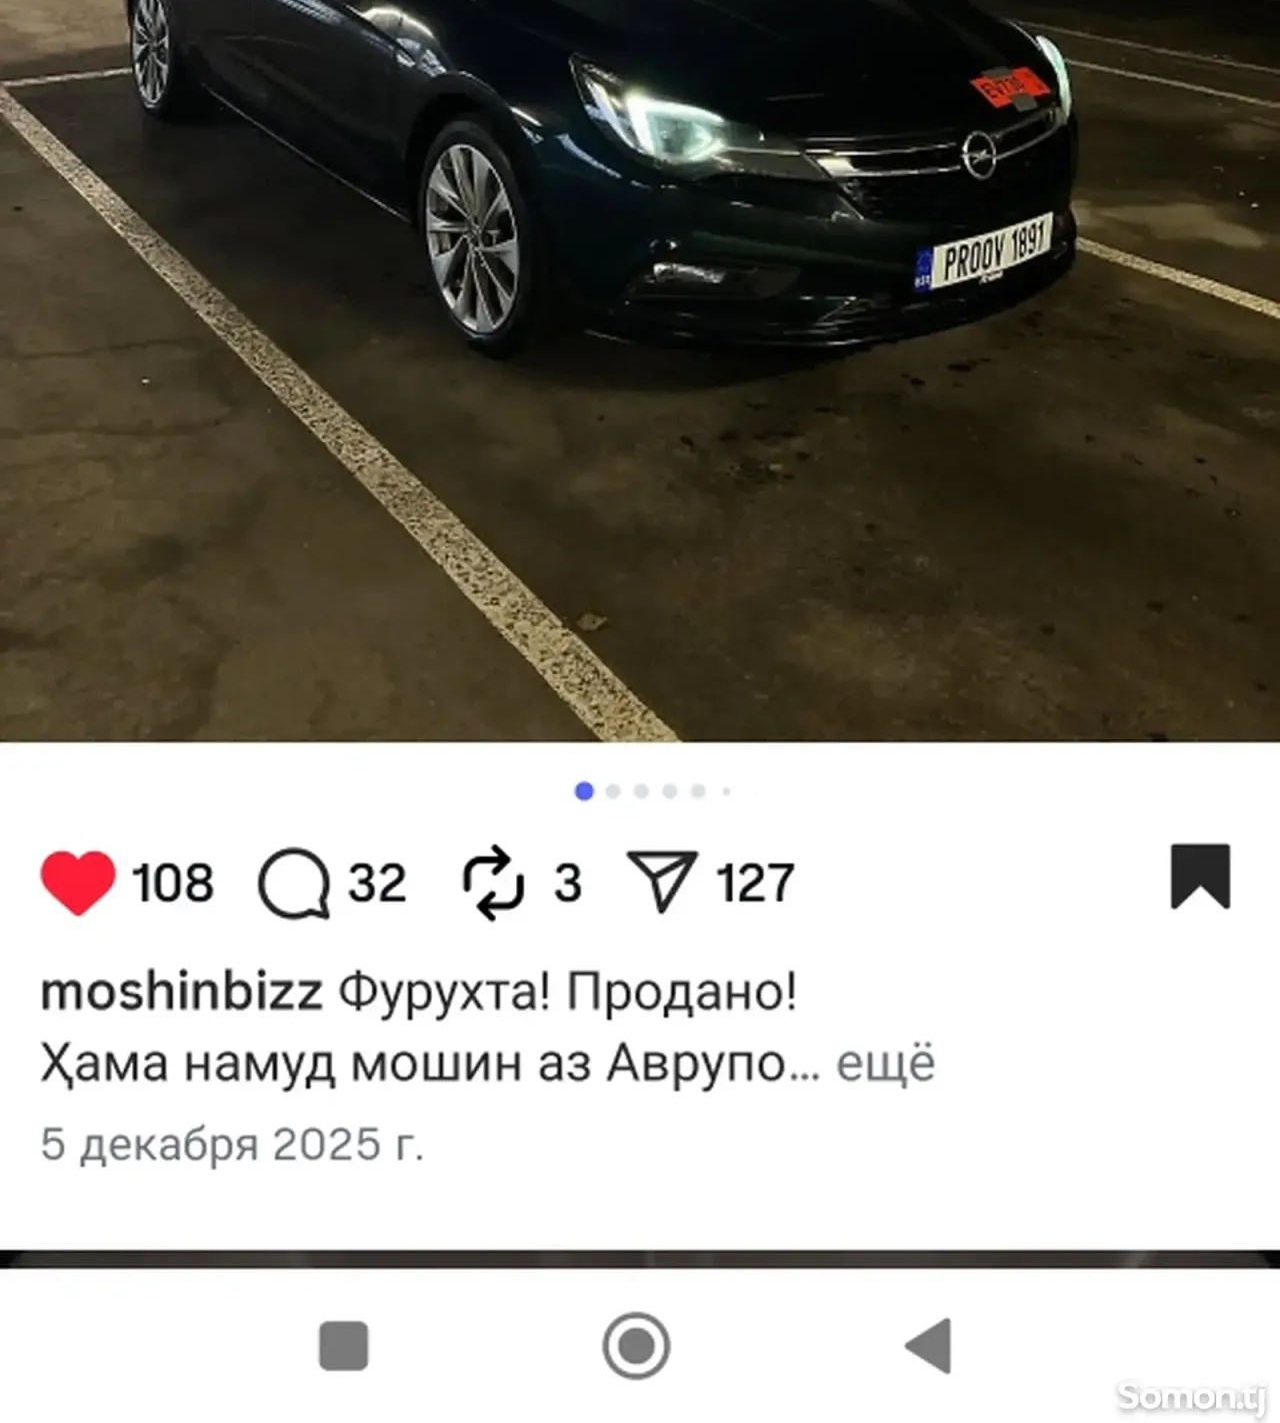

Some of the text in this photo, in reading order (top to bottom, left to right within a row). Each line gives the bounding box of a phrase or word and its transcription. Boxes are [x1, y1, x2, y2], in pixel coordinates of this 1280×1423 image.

[1011, 220, 1045, 261] 1891
[132, 863, 214, 903] 108
[348, 863, 407, 903] 32
[555, 863, 582, 903] 3
[717, 863, 796, 903] 127
[41, 968, 796, 1021] moshinbizz Фурухта! Продано!
[41, 1042, 168, 1091] Ҳама
[186, 1051, 337, 1092] намуд
[353, 1051, 521, 1083] мошин
[539, 1051, 591, 1083] аз
[837, 1042, 935, 1090] ещё
[42, 1124, 423, 1171] 5 декабря 2025 г.
